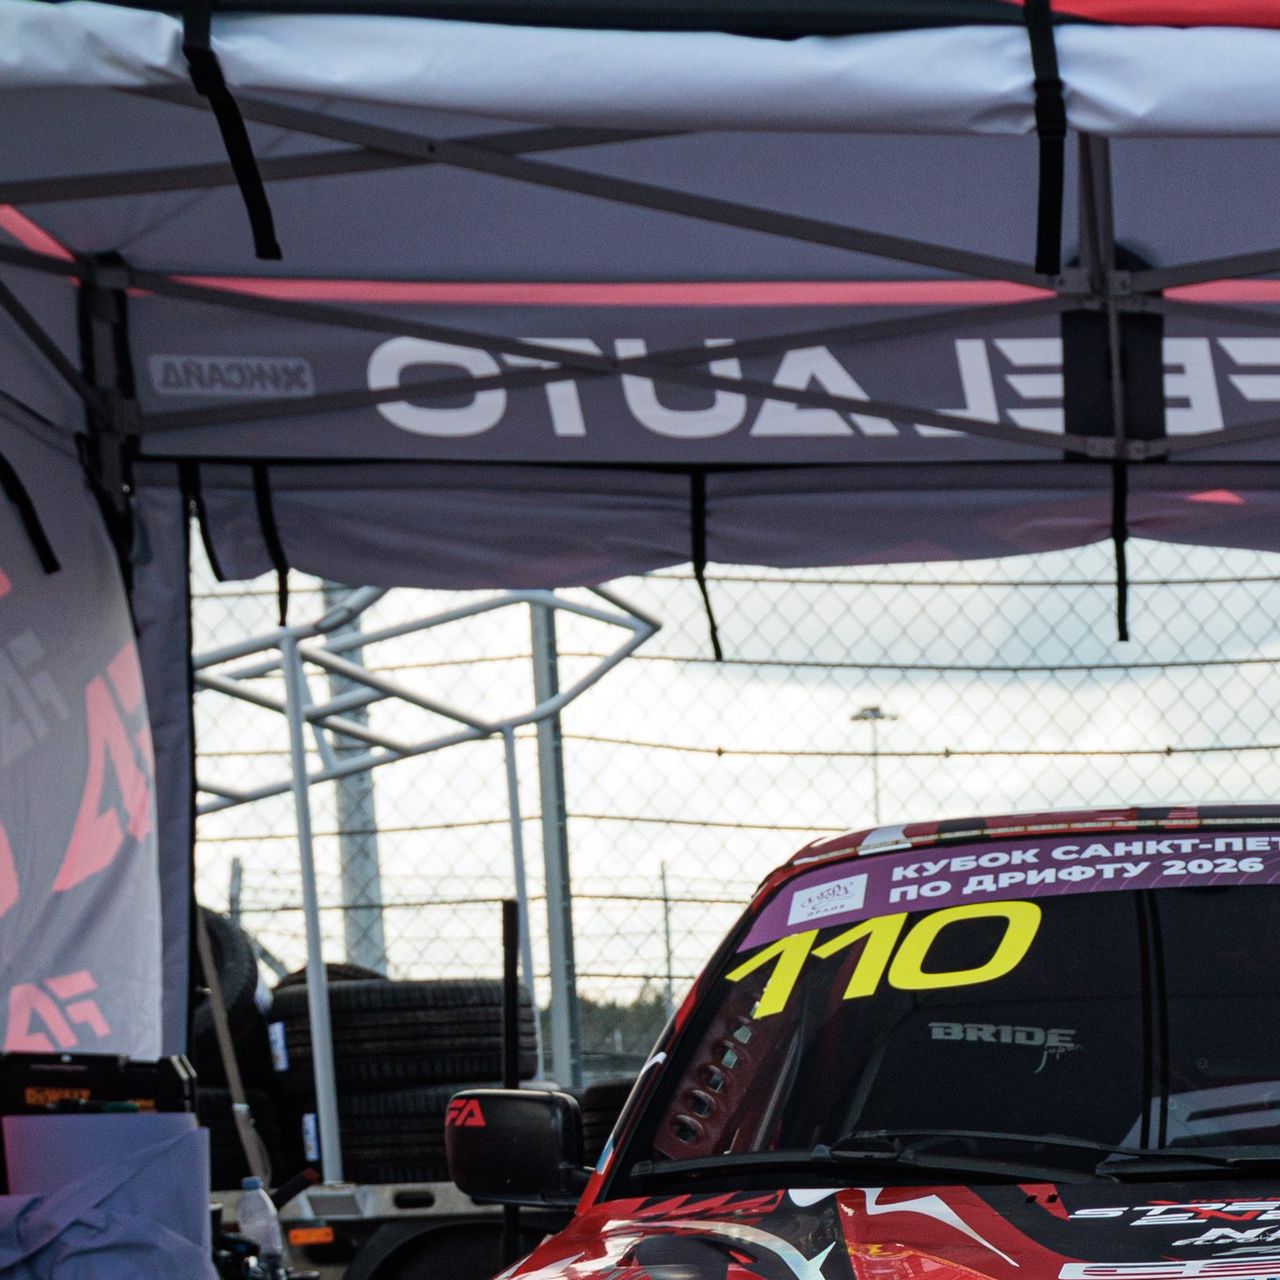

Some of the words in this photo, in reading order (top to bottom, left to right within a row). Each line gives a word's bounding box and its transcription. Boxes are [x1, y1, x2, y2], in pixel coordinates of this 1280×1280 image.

[889, 880, 952, 903] ПО
[961, 861, 1151, 895] ДРИФТУ
[1161, 857, 1265, 876] 2026
[892, 848, 1040, 882] КУБОК
[724, 900, 1042, 1020] 110
[928, 1022, 1077, 1047] BRIDE
